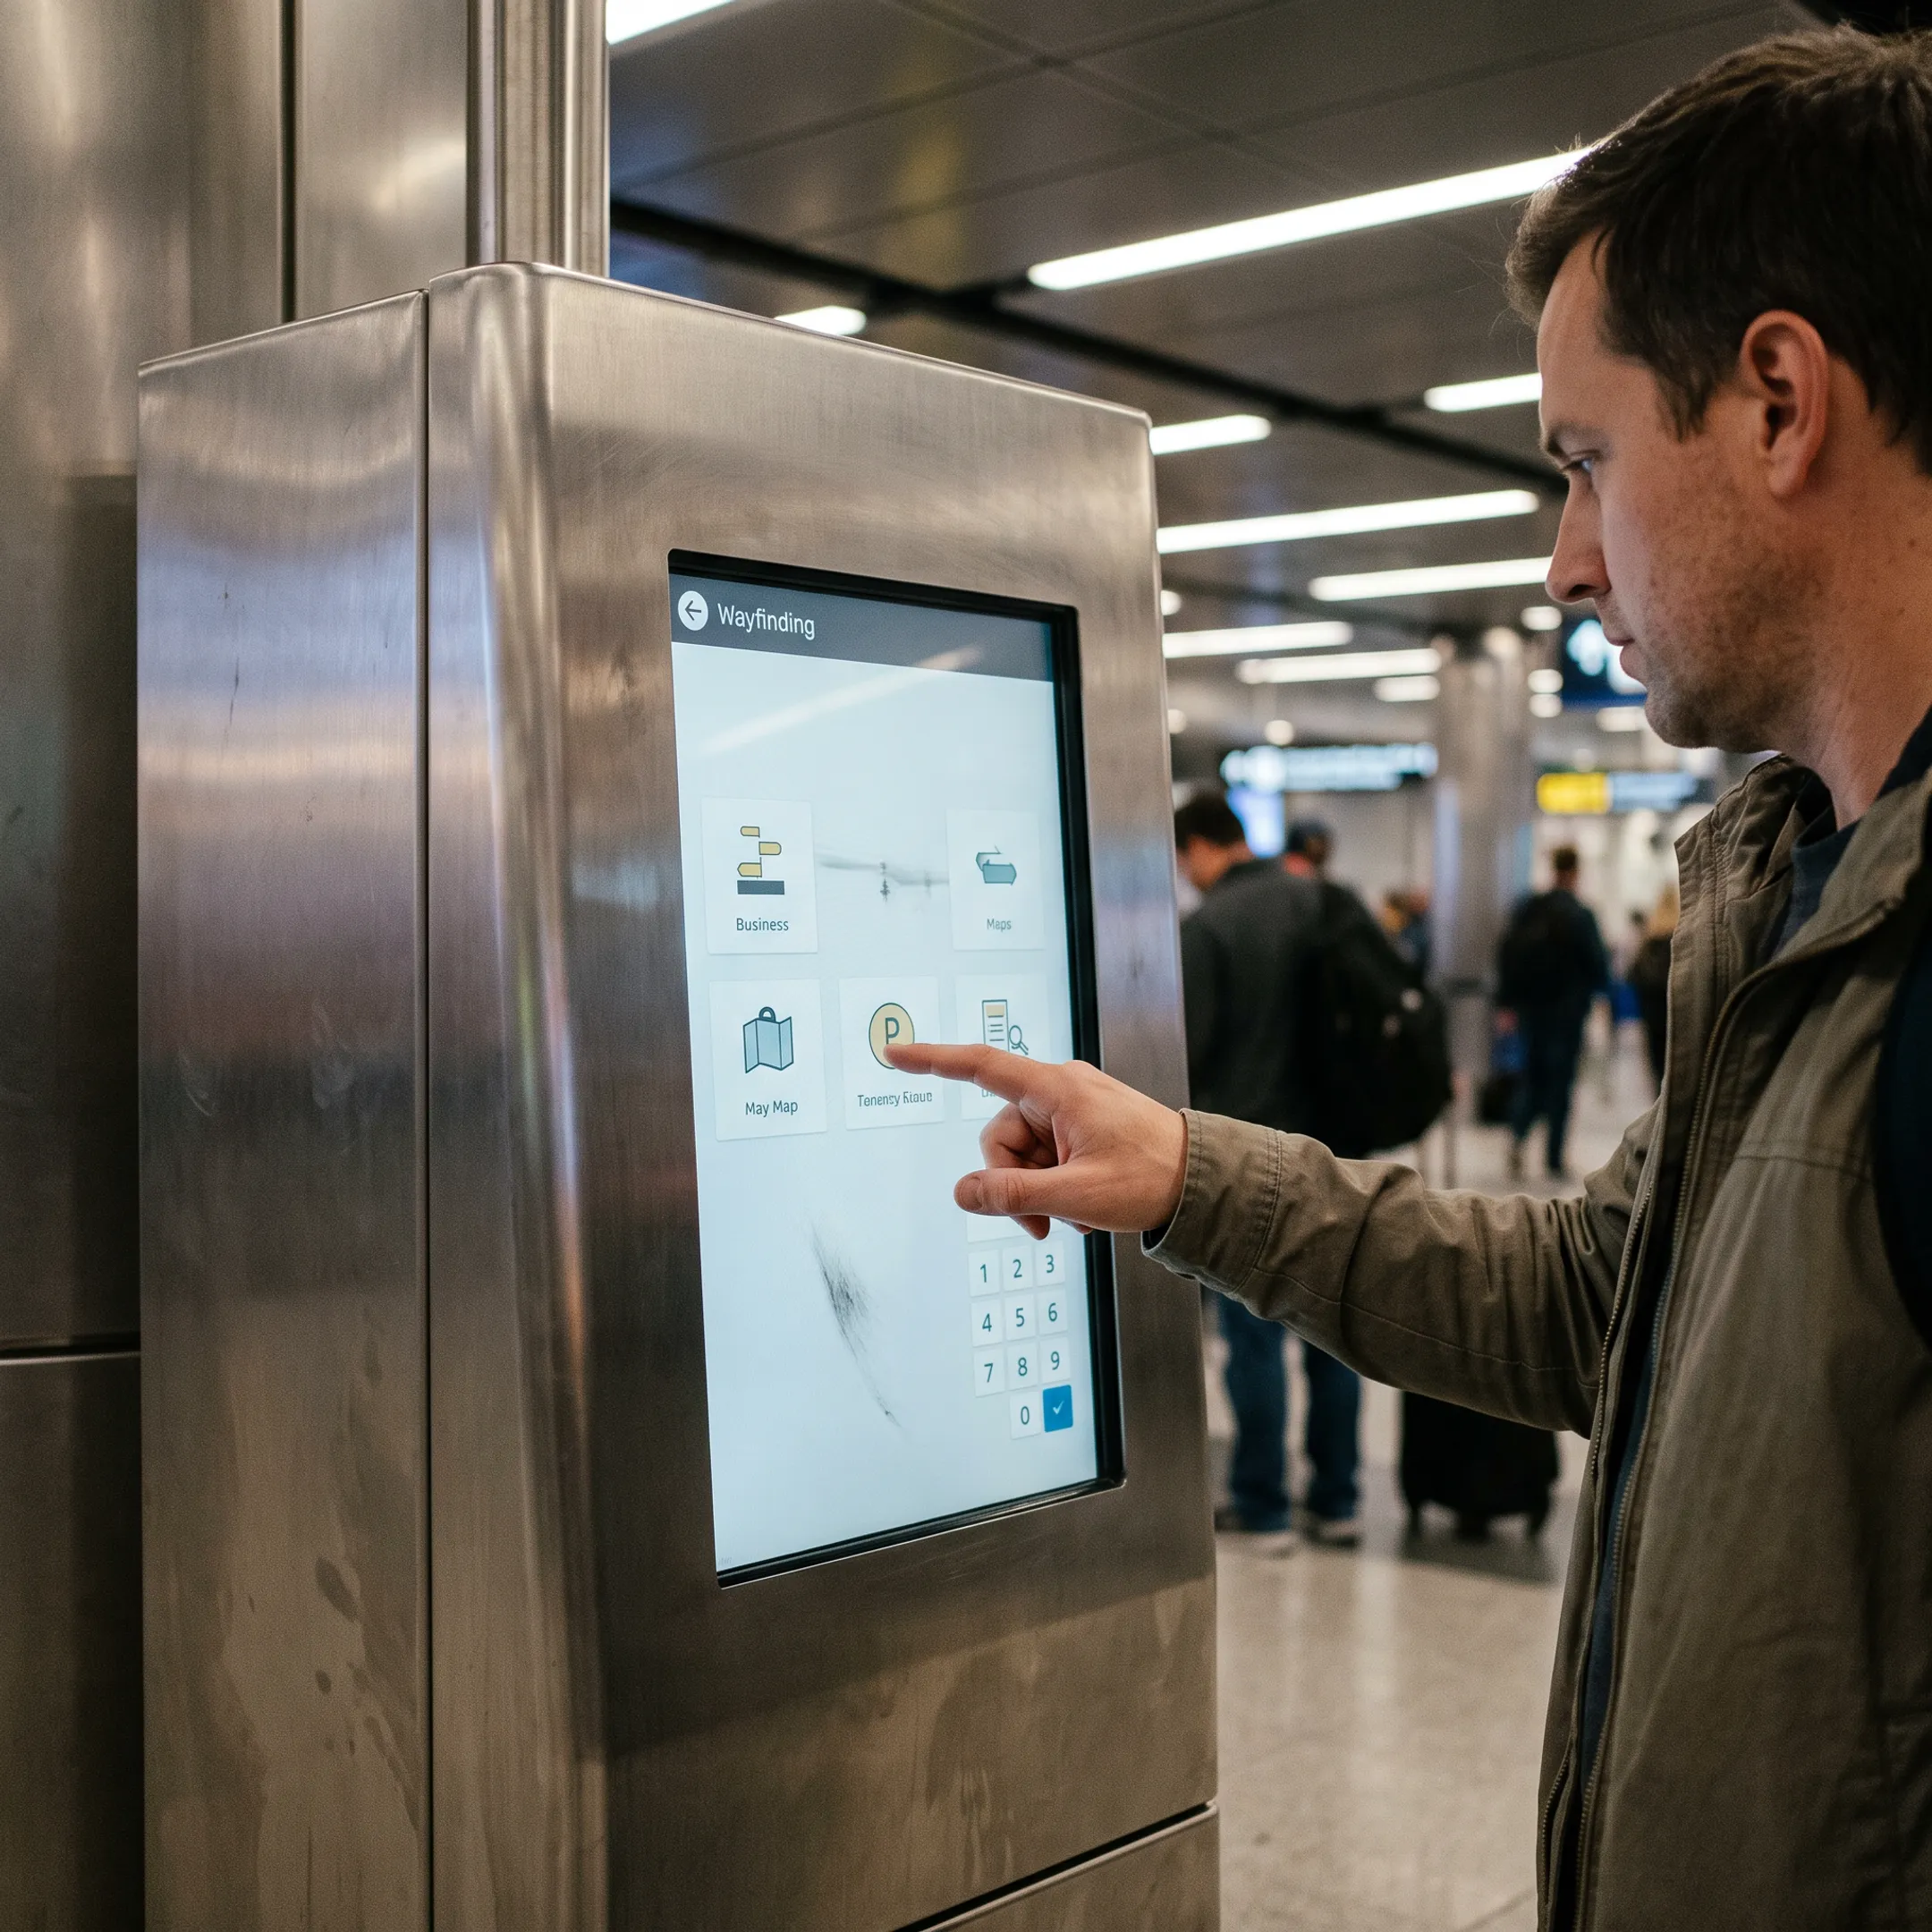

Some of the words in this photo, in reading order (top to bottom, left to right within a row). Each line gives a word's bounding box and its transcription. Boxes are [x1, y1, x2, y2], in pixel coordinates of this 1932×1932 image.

[717, 603, 815, 640] Wayfinding
[736, 917, 789, 931] Business
[987, 918, 1012, 932] Maps
[885, 1017, 900, 1045] P
[745, 1102, 769, 1117] May
[773, 1100, 799, 1115] Map
[980, 1263, 987, 1284] 1
[1013, 1258, 1022, 1278] 2
[1045, 1254, 1055, 1274] 3
[982, 1313, 992, 1332] 4
[1015, 1307, 1025, 1327] 5
[1048, 1302, 1058, 1322] 6
[984, 1362, 994, 1383] 7
[1018, 1357, 1028, 1377] 8
[1050, 1351, 1060, 1370] 9
[1020, 1405, 1030, 1425] 0
